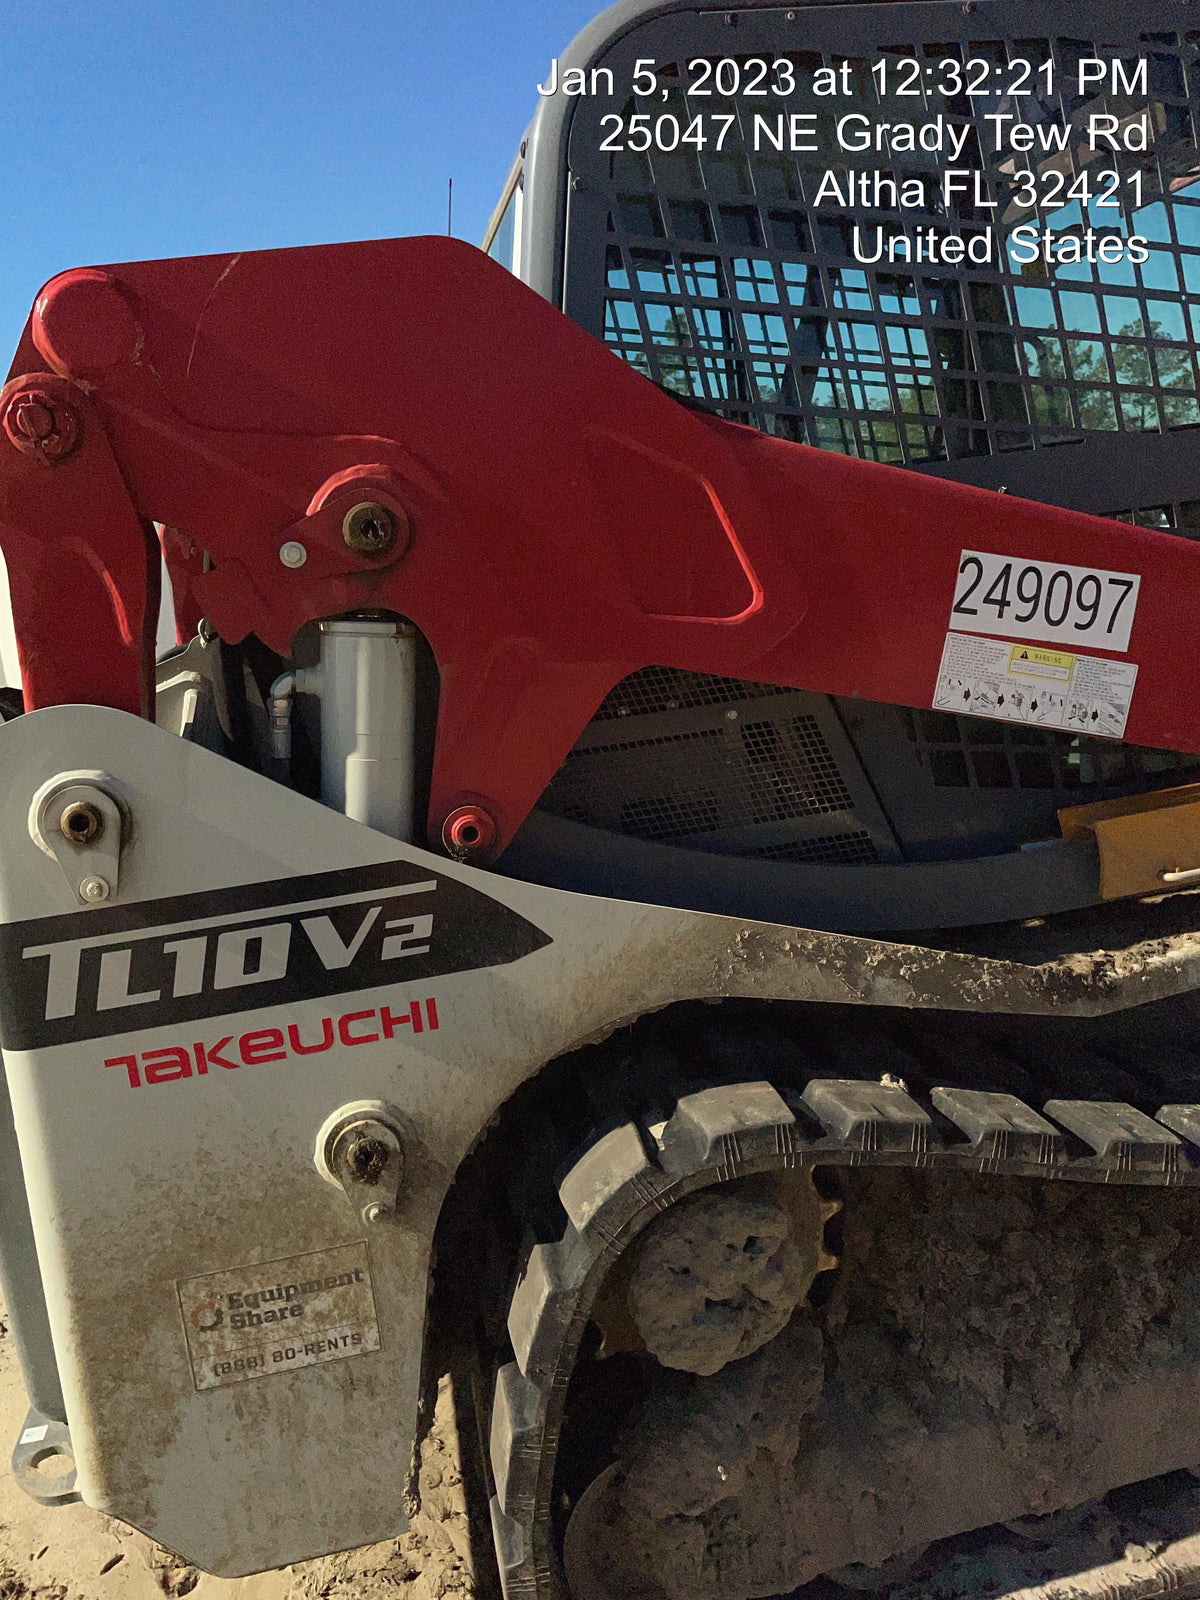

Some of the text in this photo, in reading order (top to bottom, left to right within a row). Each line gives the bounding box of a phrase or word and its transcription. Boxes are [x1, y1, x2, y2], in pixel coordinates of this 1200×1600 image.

[953, 557, 1134, 634] 249097
[226, 1266, 364, 1311] Equipment
[229, 1303, 304, 1331] Share
[272, 1332, 363, 1364] 80-RENTS
